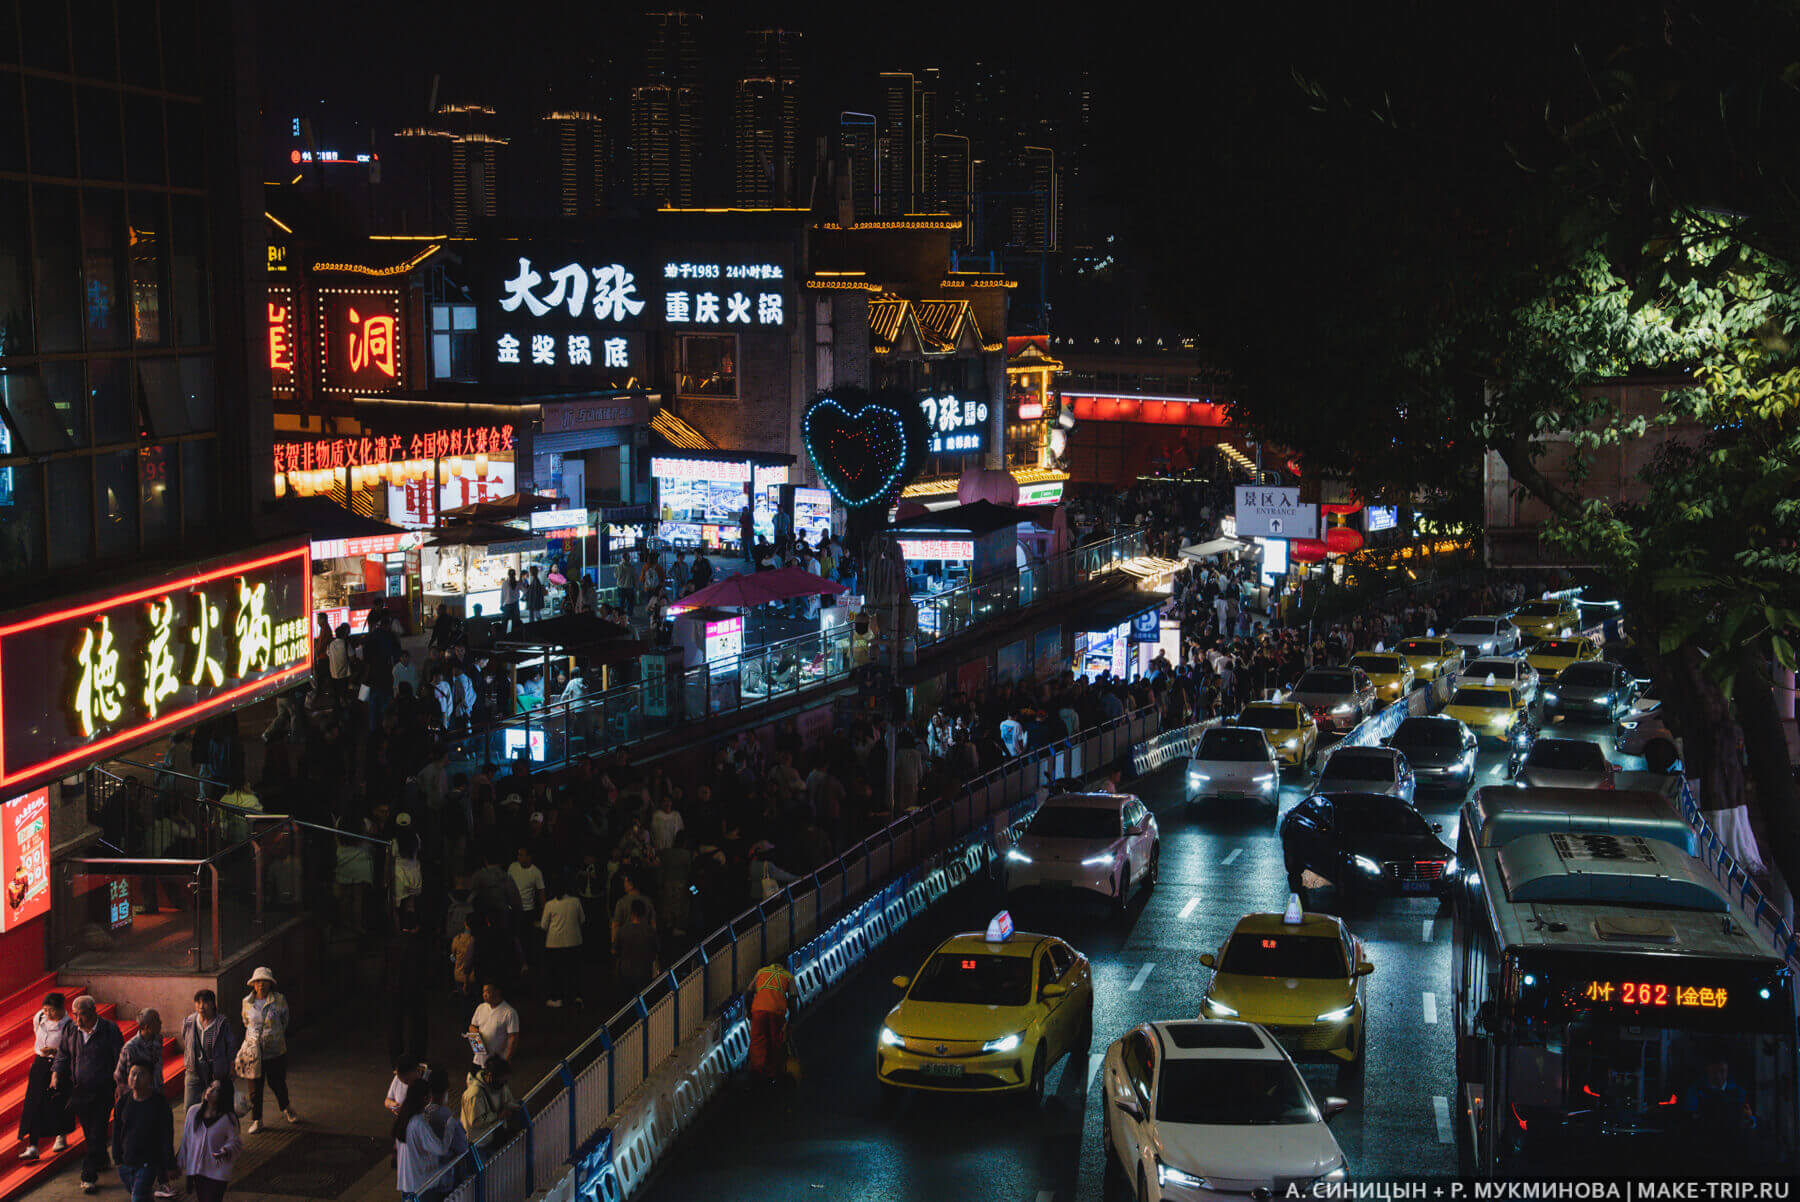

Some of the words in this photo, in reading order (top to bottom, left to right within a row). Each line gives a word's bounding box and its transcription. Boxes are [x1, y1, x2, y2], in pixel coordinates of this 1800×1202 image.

[664, 264, 720, 279] 始于1983
[726, 264, 784, 279] 24小时营业
[499, 257, 646, 322] 大刀张
[665, 291, 784, 325] 重庆火锅
[497, 333, 629, 368] 金奖锅底
[1256, 507, 1297, 516] ENTRANCE
[275, 638, 310, 666] NO.0188
[1622, 982, 1668, 1006] 262
